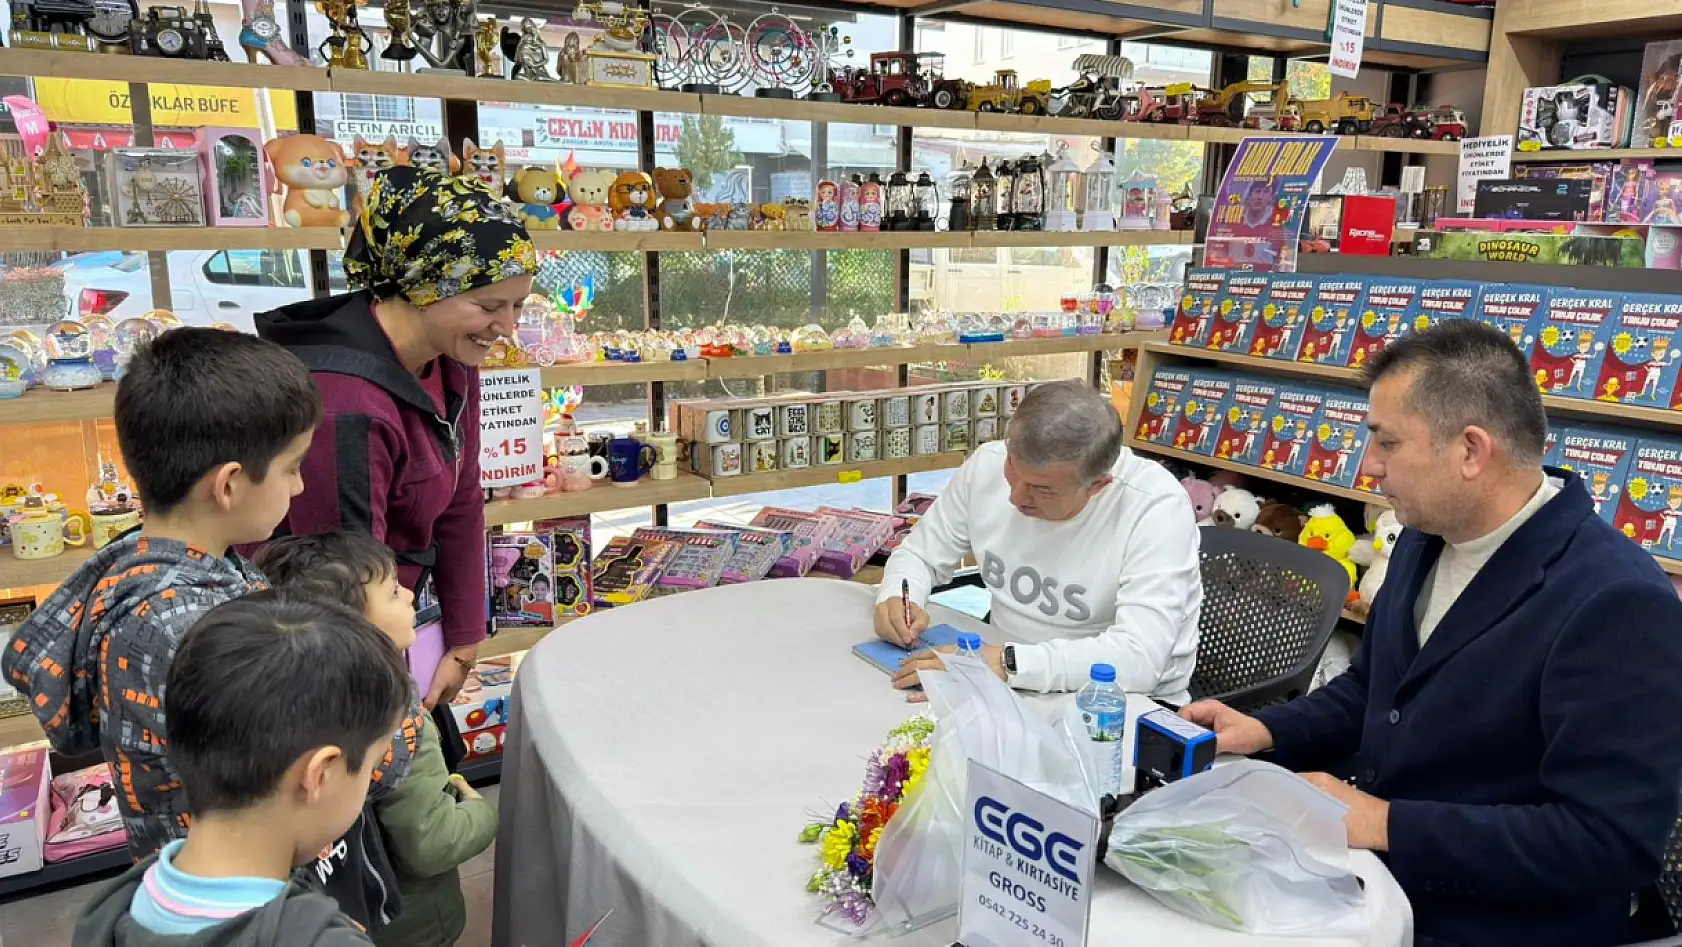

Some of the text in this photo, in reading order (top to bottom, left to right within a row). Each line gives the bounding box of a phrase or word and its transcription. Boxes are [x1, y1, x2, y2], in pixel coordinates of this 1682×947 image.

[198, 94, 240, 113] BÜFE
[1478, 240, 1541, 256] DINOSAUR
[1487, 250, 1527, 262] WORLD
[1663, 303, 1682, 313] KRA
[479, 373, 530, 387] EDİYELİK
[480, 388, 536, 402] ÜNLERDE
[482, 404, 523, 417] ETİKET
[480, 416, 537, 431] YATINDAN
[1565, 436, 1628, 450] GERÇEK KRAL
[1638, 447, 1677, 462] GERÇEK
[481, 463, 536, 481] NDİRİM
[982, 550, 1091, 621] BOSS
[974, 795, 1085, 886] EGE
[973, 834, 1079, 902] KİTAP & KIRTASİYE
[989, 870, 1047, 914] GROSS
[978, 893, 1064, 947] 0542 725 24 30
